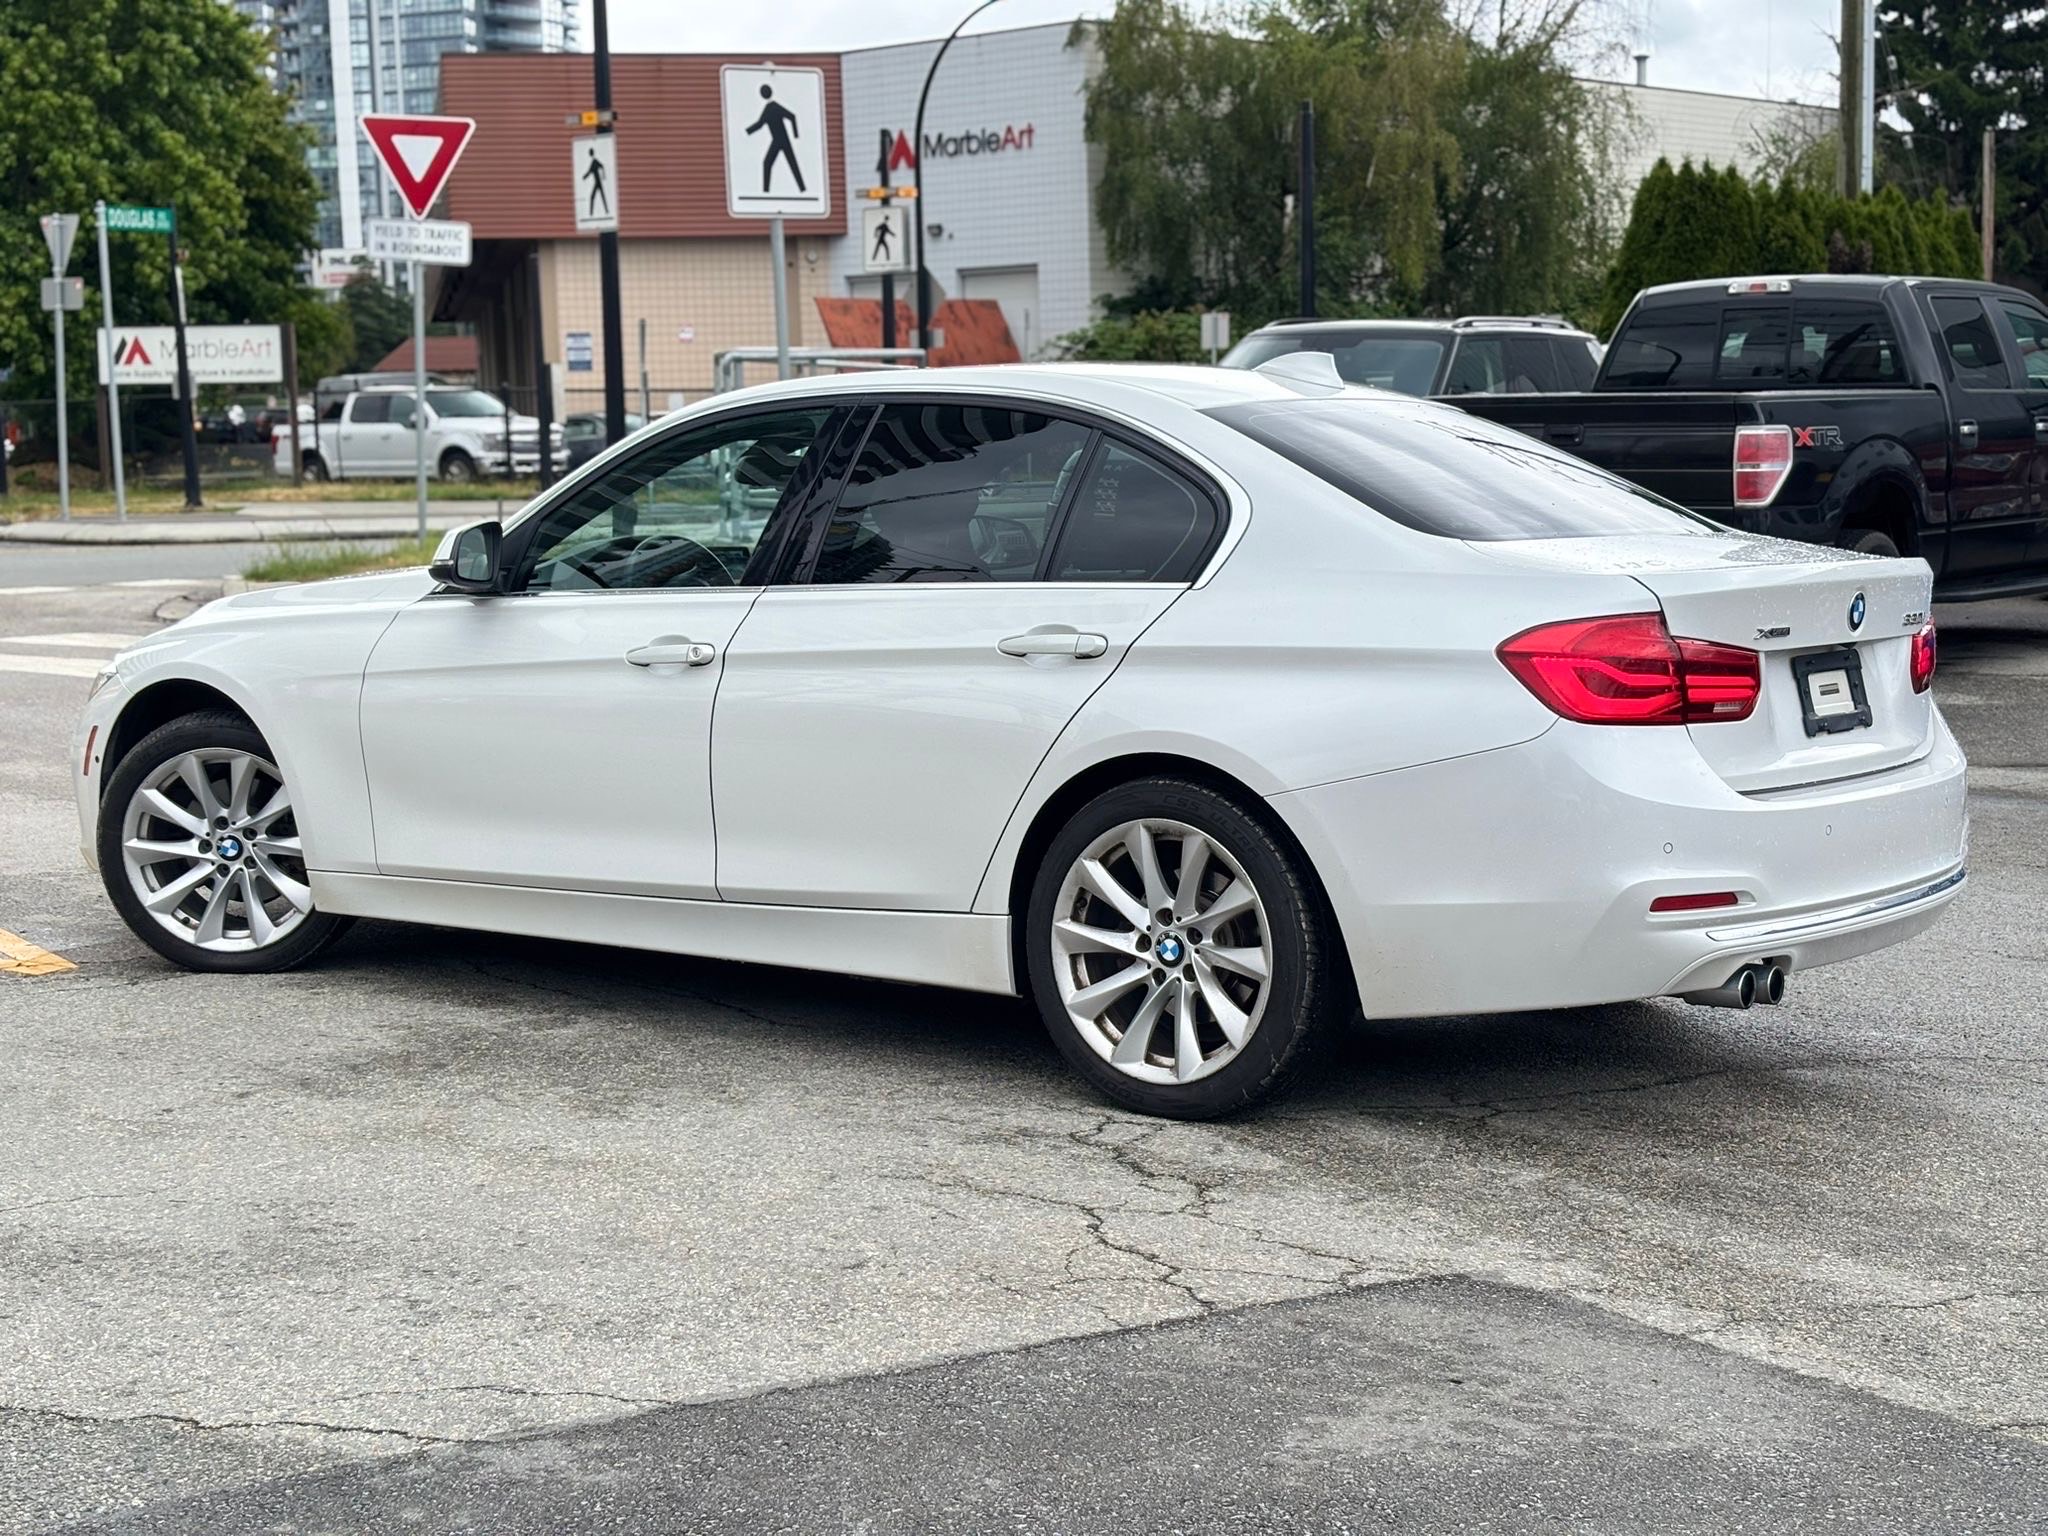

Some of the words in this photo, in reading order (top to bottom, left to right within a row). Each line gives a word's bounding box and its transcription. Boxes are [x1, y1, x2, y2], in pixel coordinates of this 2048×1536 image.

[924, 123, 1035, 158] MarbleArt
[108, 208, 156, 229] DOUGLAS
[375, 225, 403, 238] YIELD
[408, 226, 421, 239] TO
[424, 228, 463, 242] TRAFFIC
[391, 242, 463, 257] ROUNDABOUT
[1793, 425, 1844, 447] XTR
